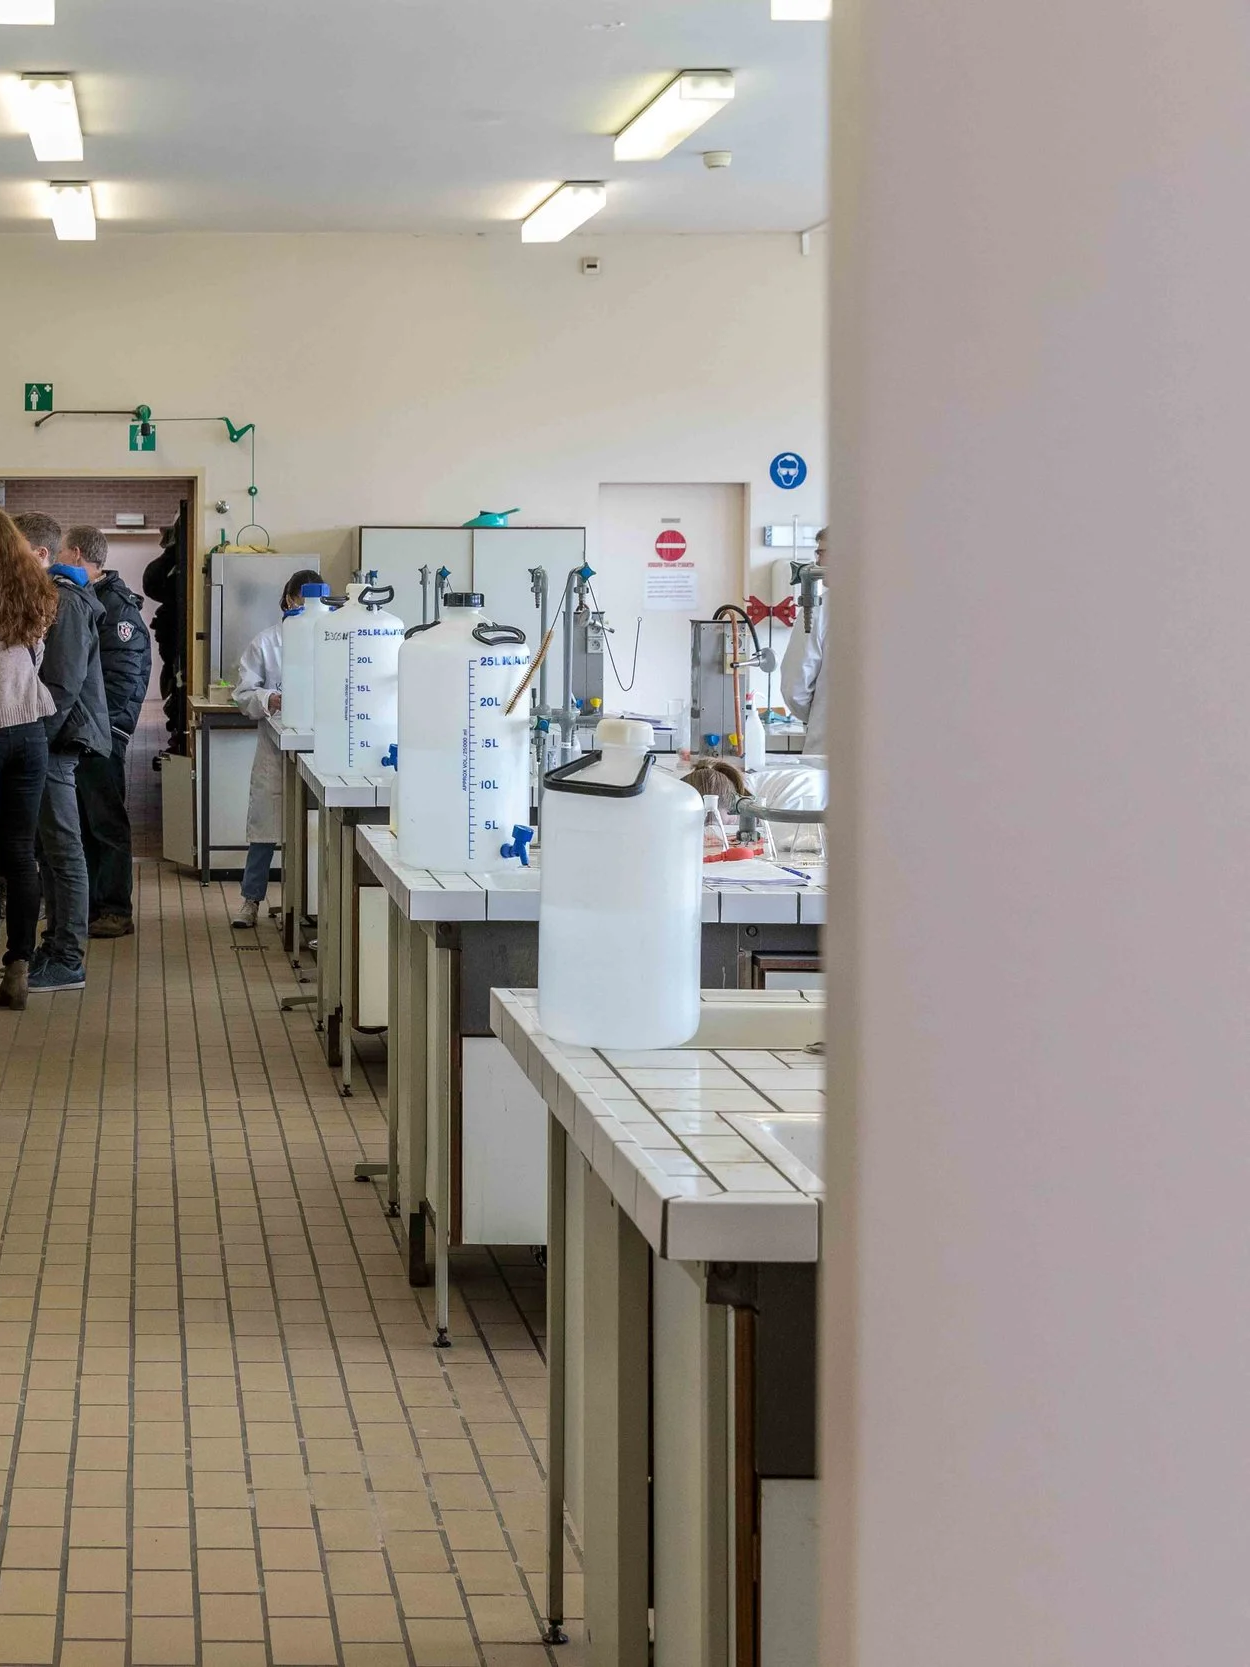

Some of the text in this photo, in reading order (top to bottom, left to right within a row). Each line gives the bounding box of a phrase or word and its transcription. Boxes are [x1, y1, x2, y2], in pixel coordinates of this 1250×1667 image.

[480, 656, 500, 666] 25L
[480, 697, 501, 707] 20L
[481, 738, 499, 748] 15L
[480, 780, 499, 790] 10L
[484, 820, 499, 830] 5L
